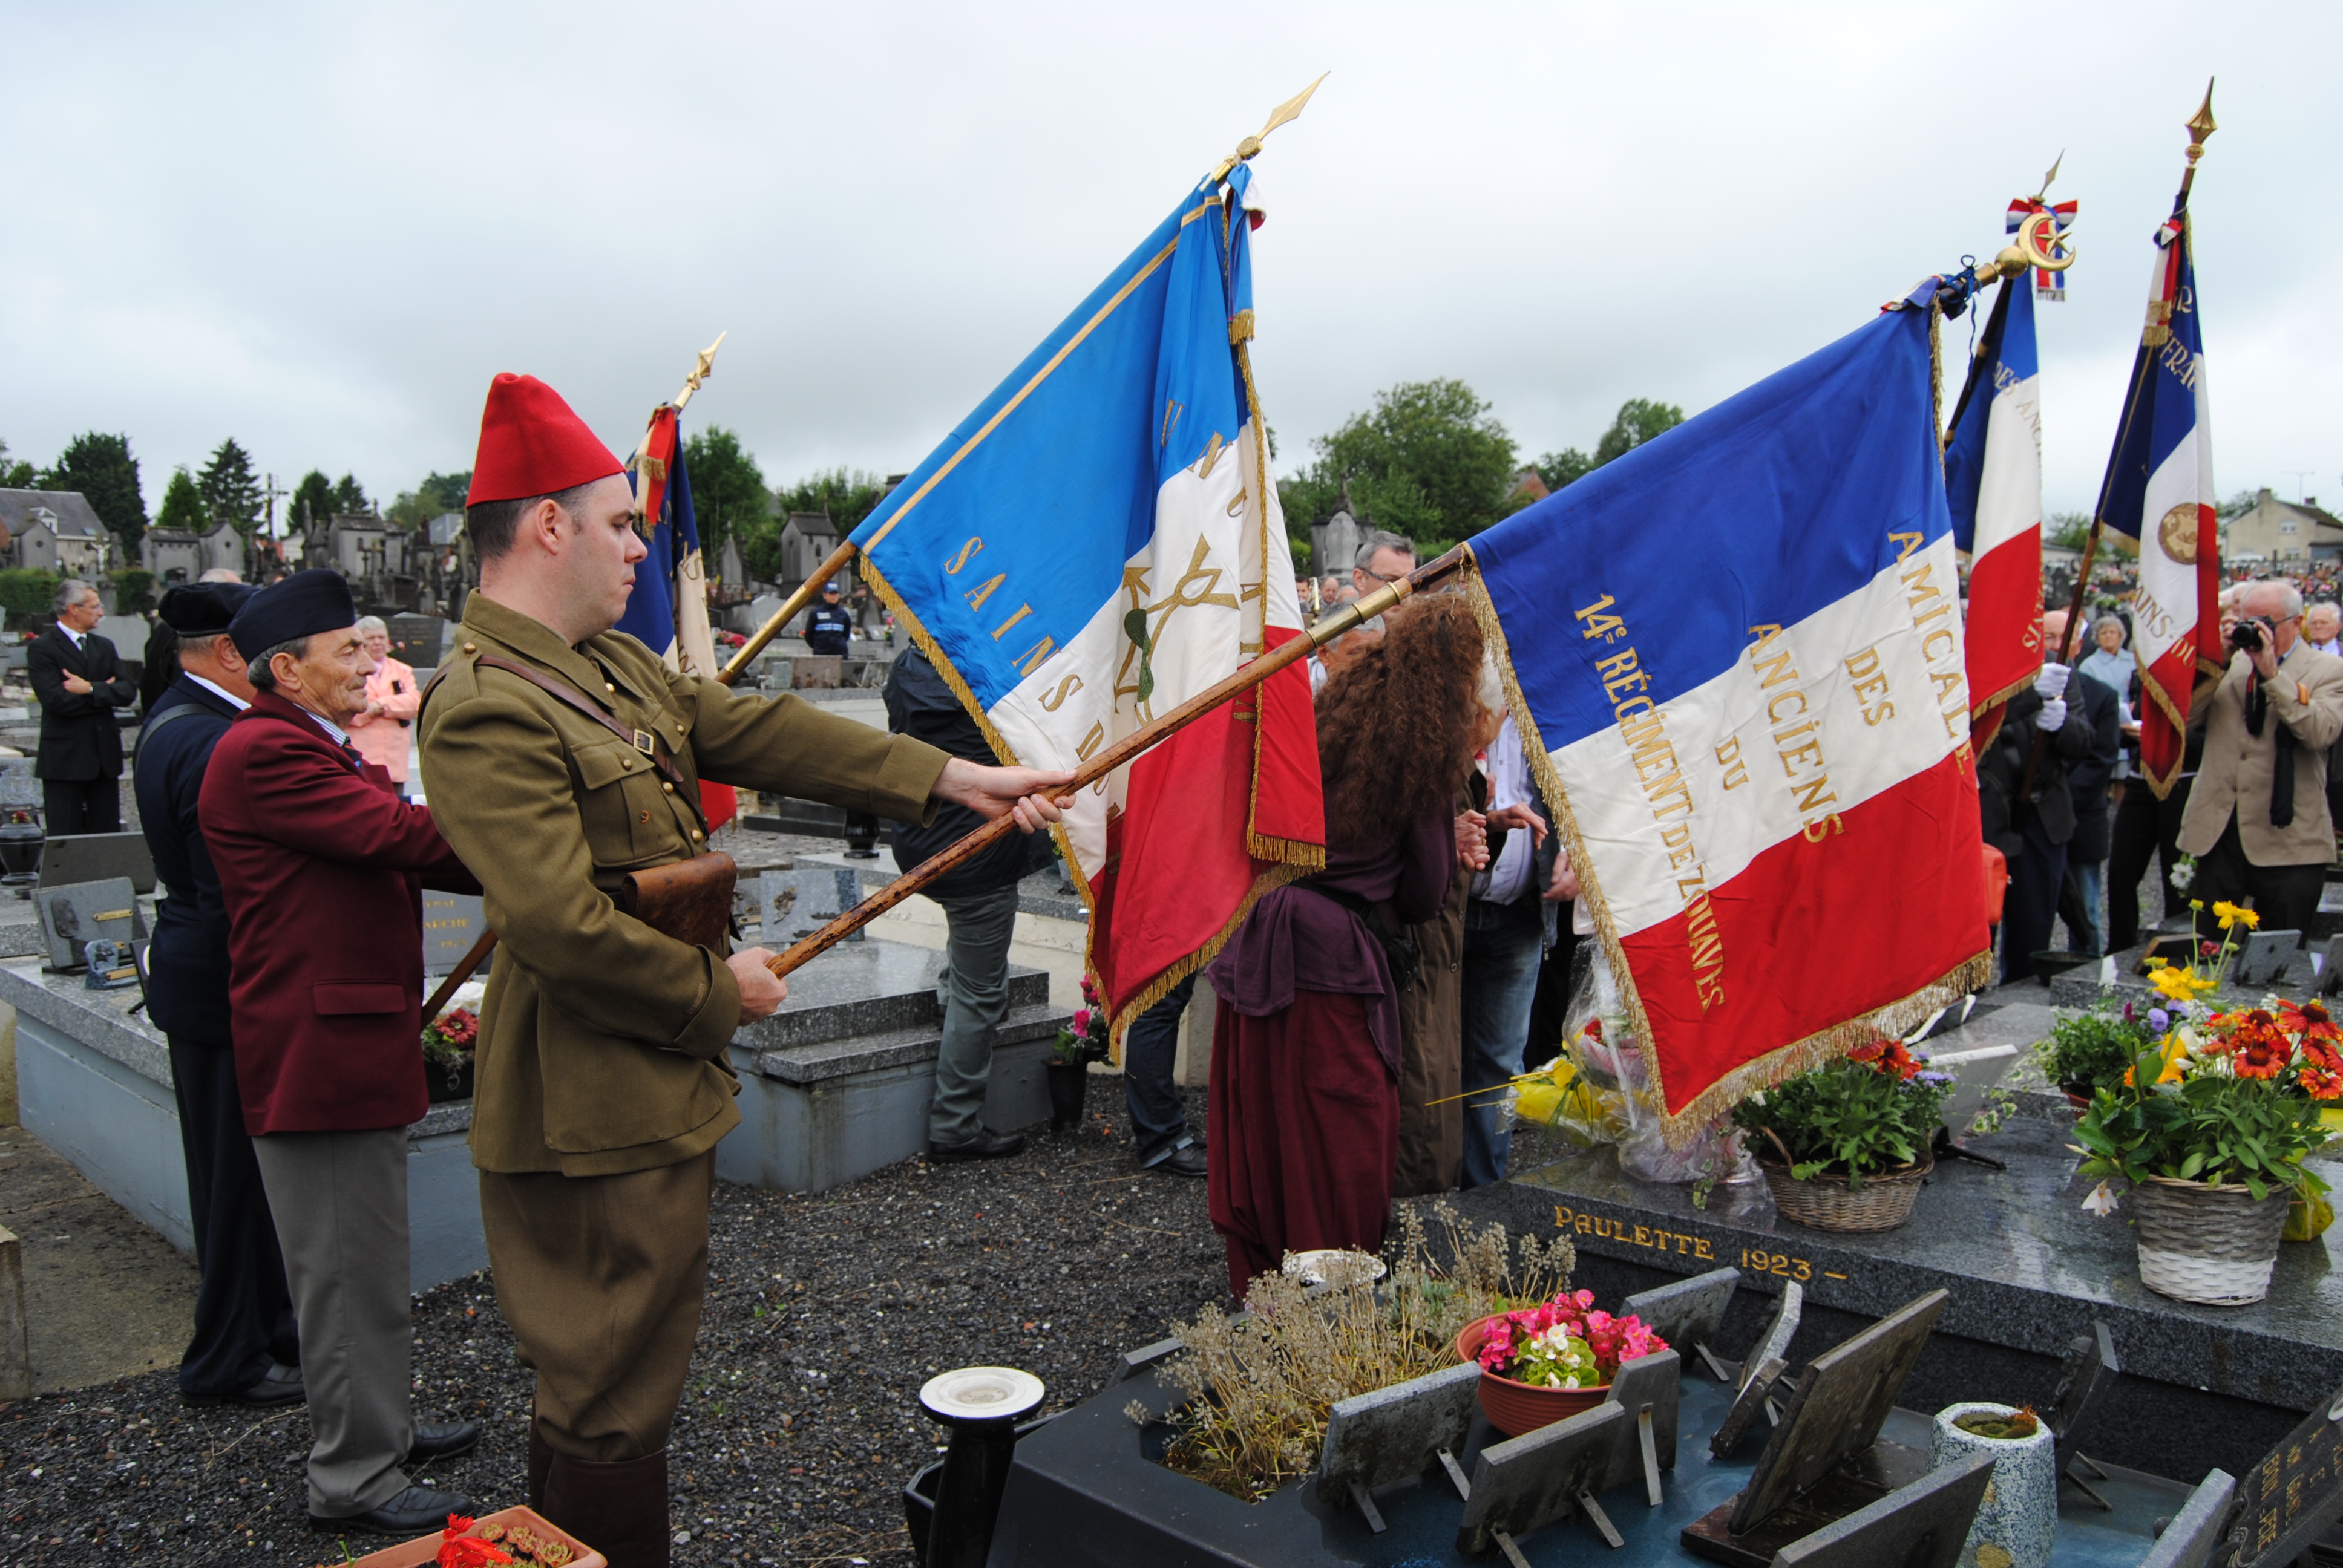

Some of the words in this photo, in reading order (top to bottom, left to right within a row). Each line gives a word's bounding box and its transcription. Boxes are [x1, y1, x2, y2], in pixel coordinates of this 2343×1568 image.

[943, 536, 1084, 713] SAINS
[1594, 645, 1693, 820] RÉGIMENT
[1748, 622, 1846, 843] ANCIENS
[1843, 645, 1895, 727] DES
[1714, 734, 1749, 791] DU
[1660, 822, 1696, 871] DE
[1677, 864, 1725, 1015] ZOUAVES
[1554, 1205, 1714, 1261] PAULETTE
[1742, 1247, 1812, 1281] 1923
